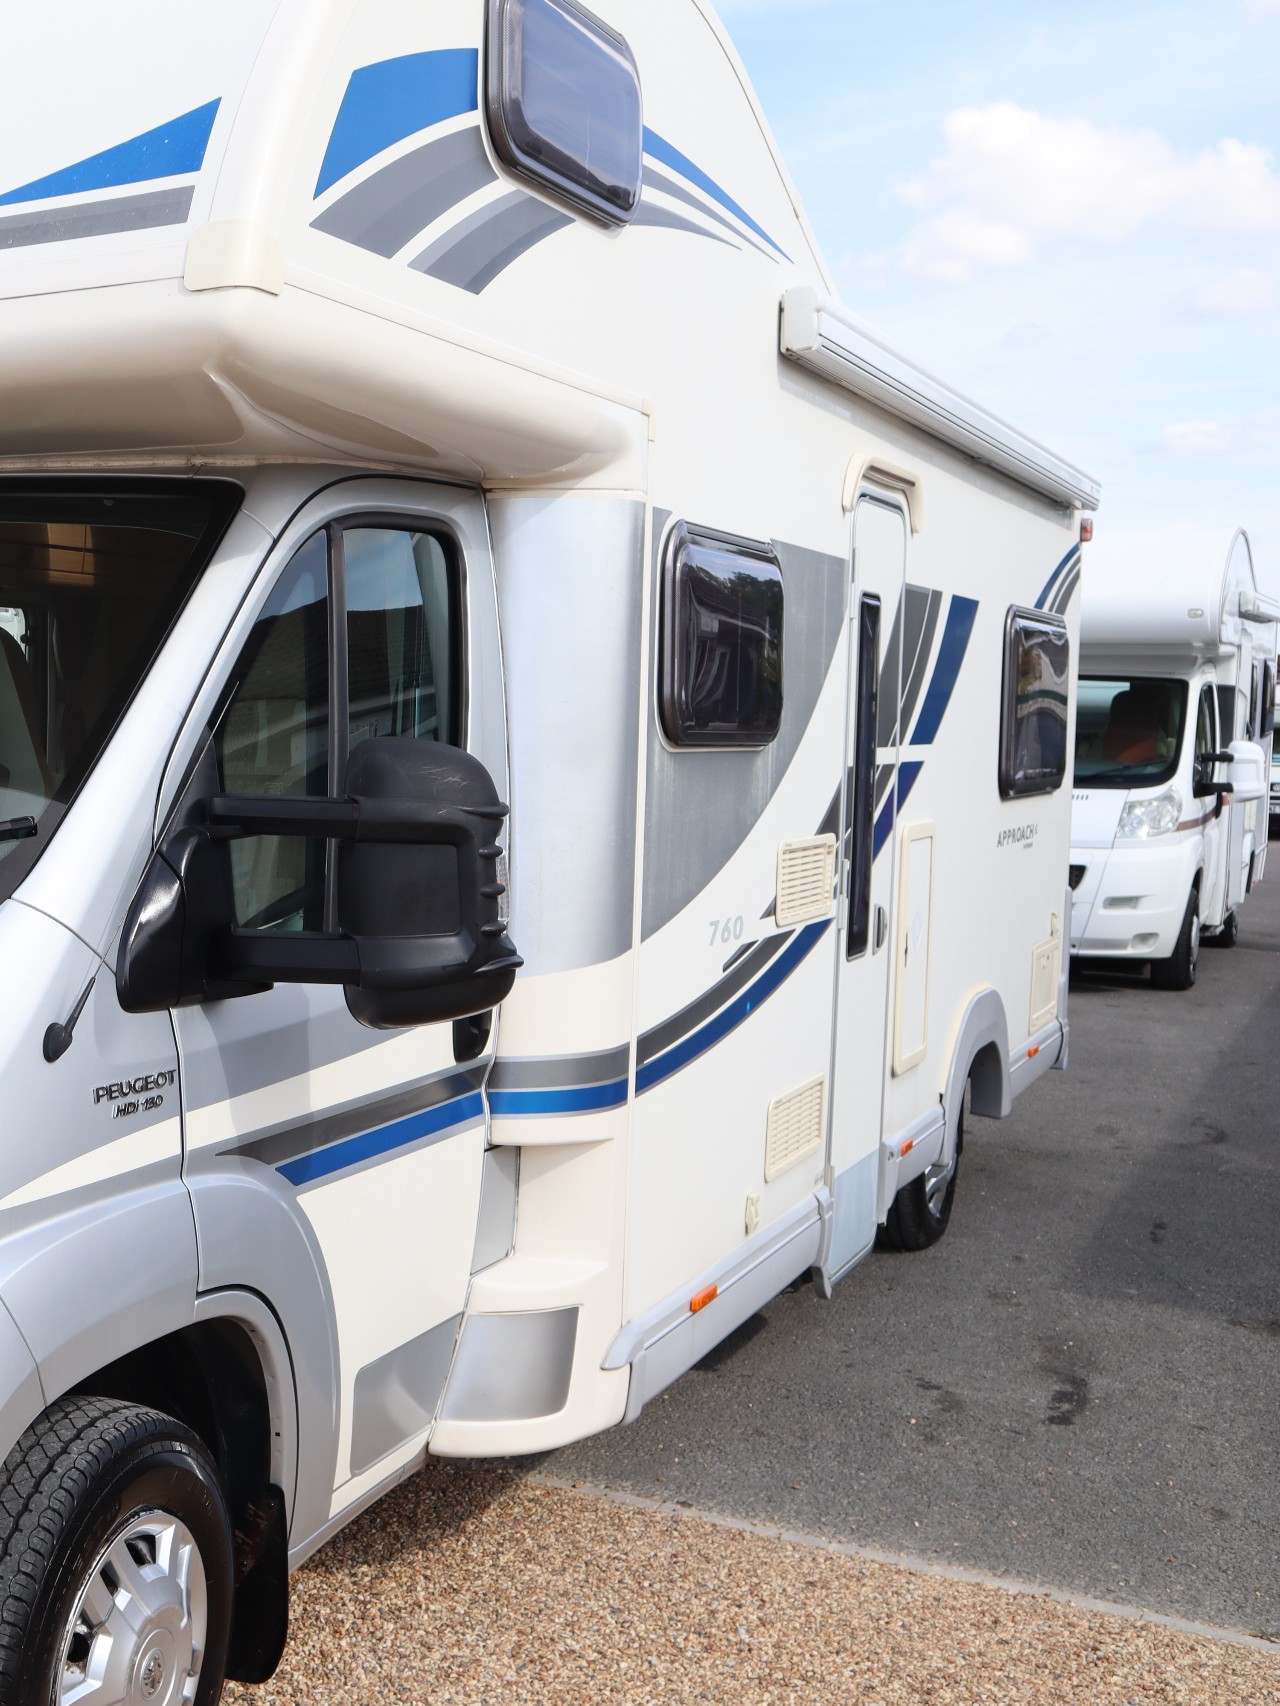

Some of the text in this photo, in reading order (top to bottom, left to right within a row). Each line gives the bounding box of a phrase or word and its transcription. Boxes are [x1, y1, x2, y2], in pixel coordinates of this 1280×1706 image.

[997, 823, 1035, 848] APPROACH
[708, 914, 744, 947] 760
[92, 1069, 177, 1104] PEUGEOT
